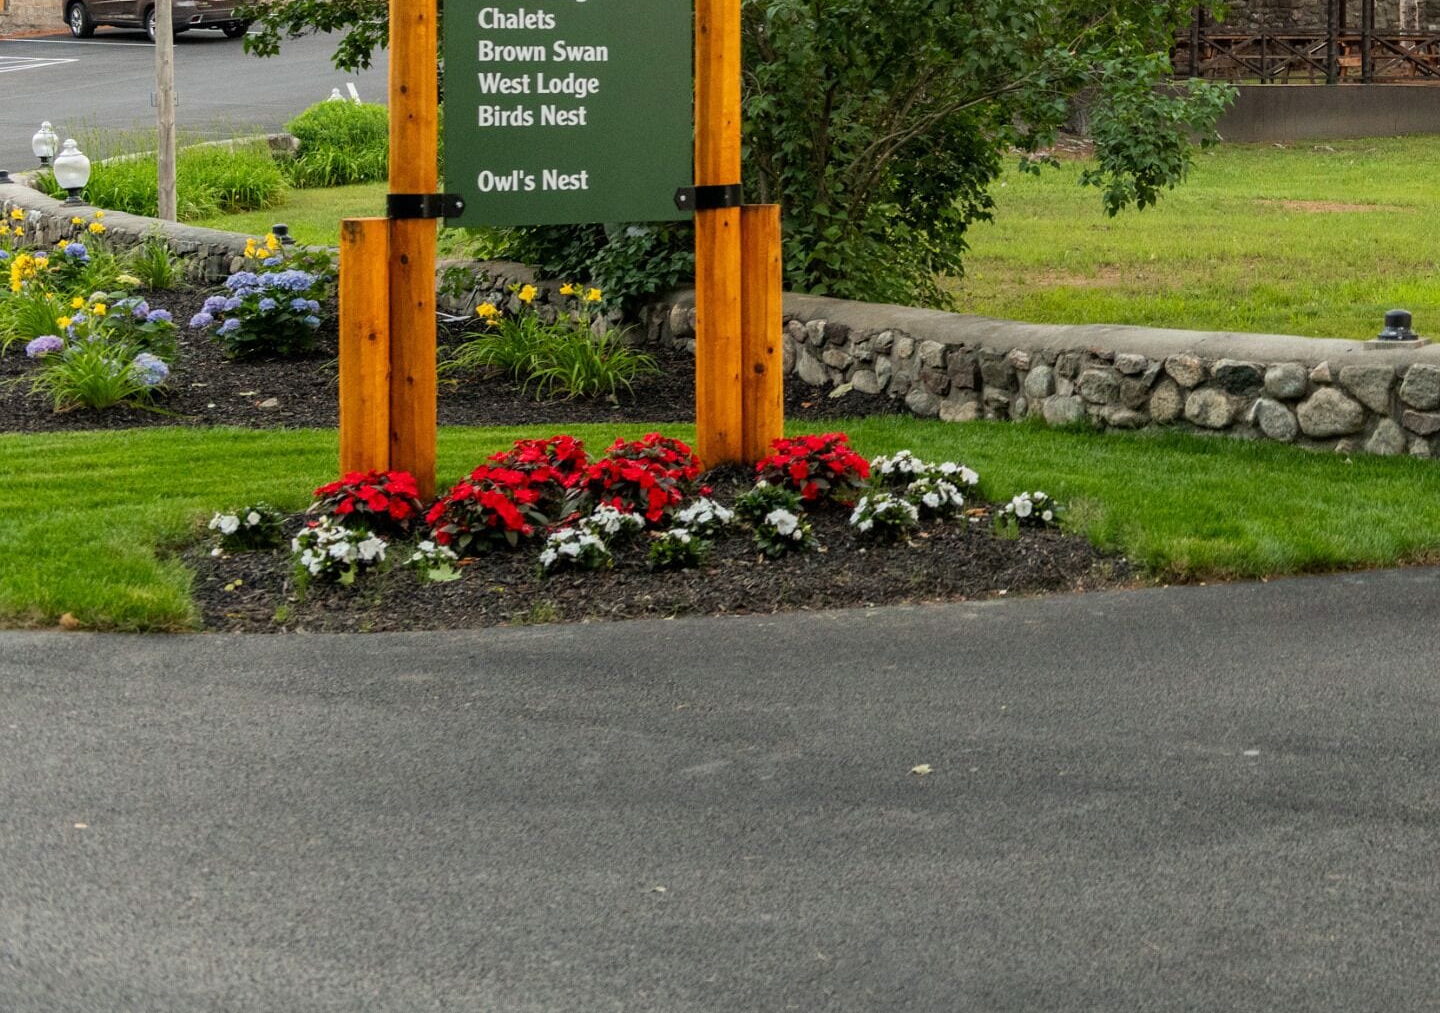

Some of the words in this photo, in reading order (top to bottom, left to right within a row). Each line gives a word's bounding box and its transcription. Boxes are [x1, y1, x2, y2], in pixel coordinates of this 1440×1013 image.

[477, 7, 556, 30] Chalets
[478, 40, 546, 62] Brown
[552, 39, 609, 62] Swan
[477, 72, 531, 94] West
[536, 72, 600, 99] Lodge
[478, 104, 534, 127] Birds
[540, 104, 587, 126] Nest
[477, 169, 536, 192] Owl's
[542, 169, 589, 191] Nest
